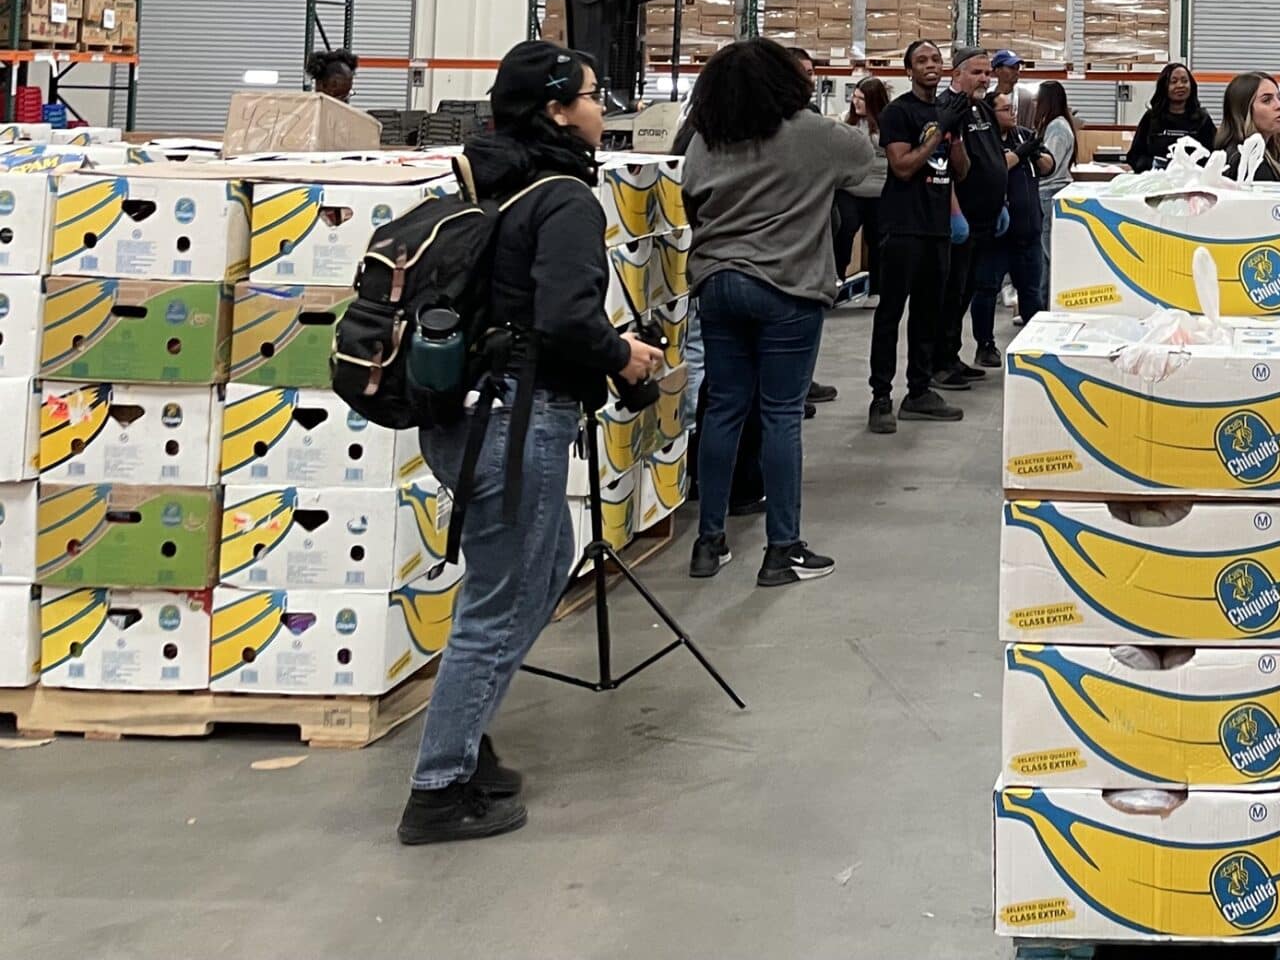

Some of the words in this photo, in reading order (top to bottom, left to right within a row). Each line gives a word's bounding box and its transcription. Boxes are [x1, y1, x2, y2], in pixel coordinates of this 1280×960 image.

[1064, 297, 1088, 307] CLASS
[1089, 294, 1114, 305] EXTRA
[1014, 456, 1044, 466] SELECTED
[1046, 453, 1073, 463] QUALITY
[1227, 438, 1279, 477] Chiquita
[1017, 464, 1043, 474] CLASS
[1045, 461, 1074, 472] EXTRA
[1015, 609, 1045, 618] SELECTED
[1046, 605, 1074, 615] QUALITY
[1227, 587, 1280, 626] Chiquita
[1018, 617, 1045, 627] CLASS
[1046, 613, 1075, 624] EXTRA
[1017, 755, 1047, 764] SELECTED
[1049, 751, 1077, 761] QUALITY
[1021, 762, 1047, 773] CLASS
[1049, 758, 1078, 770] EXTRA
[1006, 904, 1036, 914] SELECTED
[1038, 900, 1066, 910] QUALITY
[1222, 881, 1276, 922] Chiquita
[1009, 912, 1037, 923] CLASS
[1038, 909, 1066, 920] EXTRA
